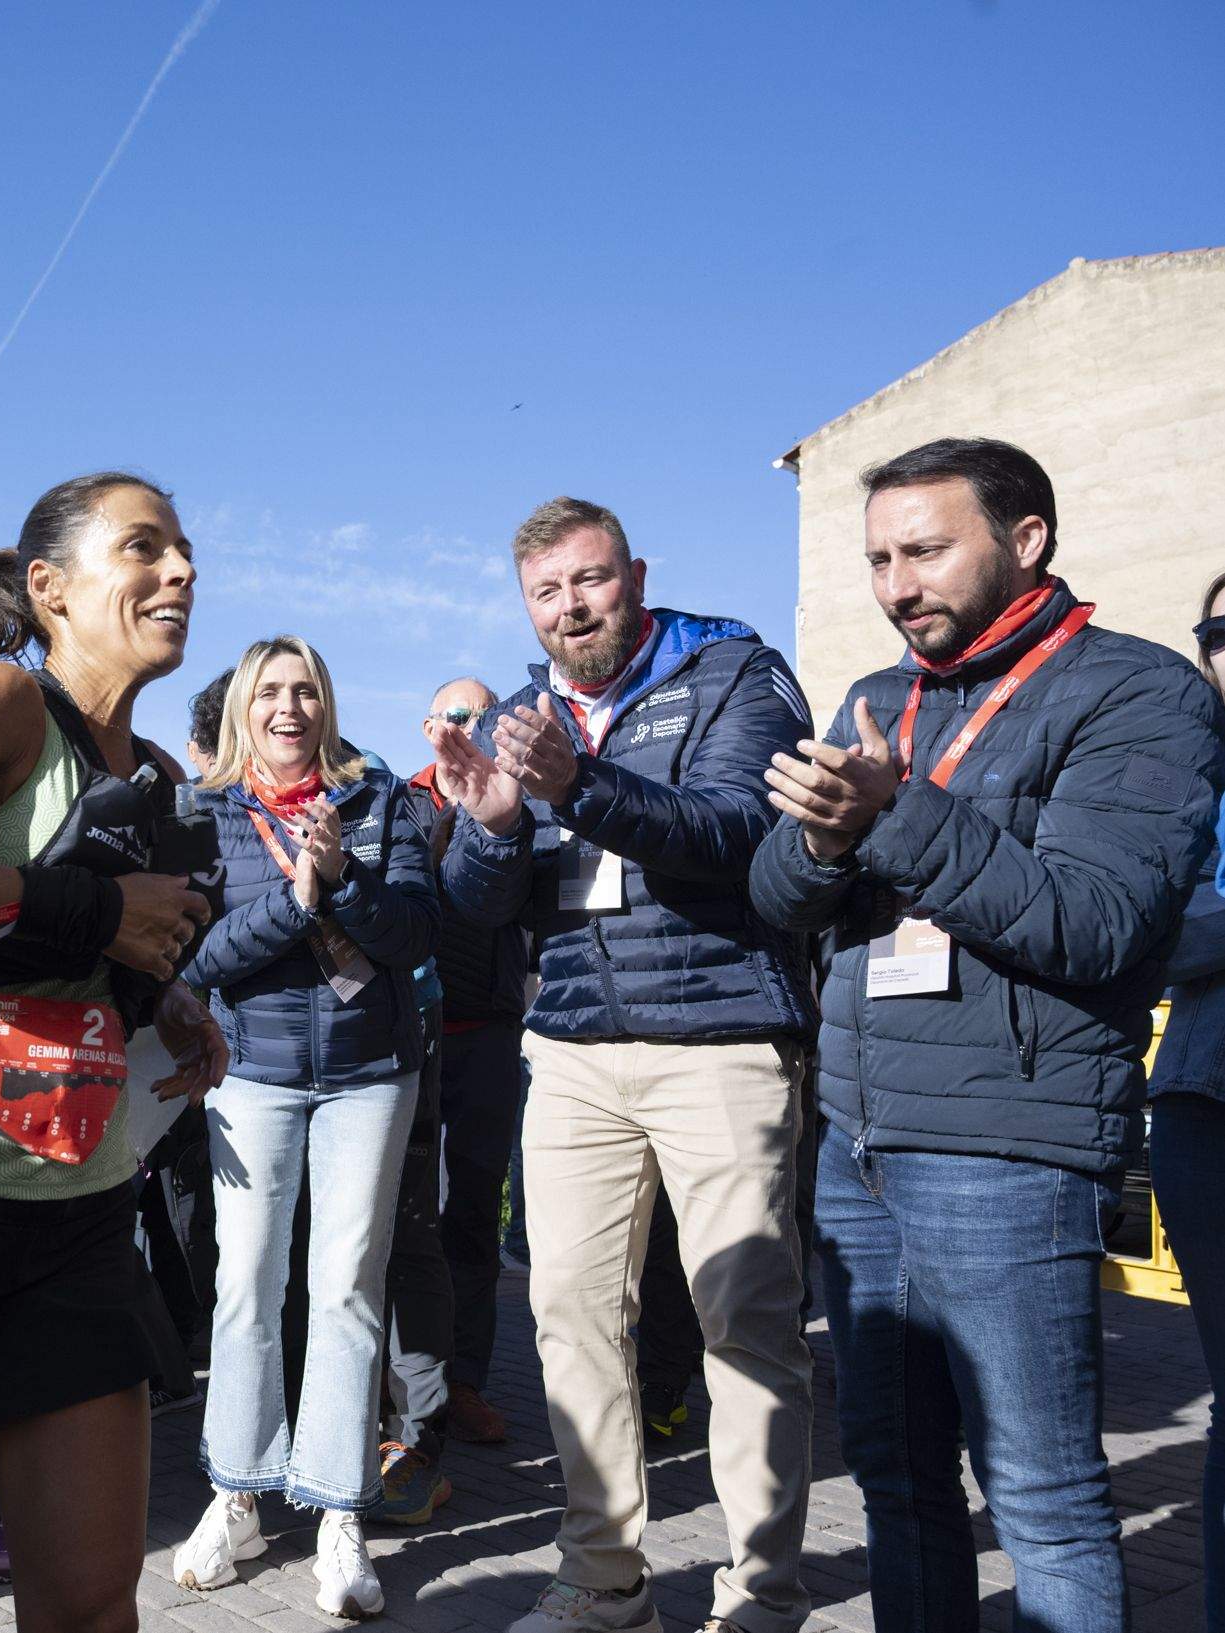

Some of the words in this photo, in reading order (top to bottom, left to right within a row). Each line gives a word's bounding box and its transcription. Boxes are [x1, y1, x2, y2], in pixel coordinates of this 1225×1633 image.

[653, 715, 688, 727] Castellón
[653, 722, 686, 732] Escenario
[653, 729, 686, 738] Deportivo
[81, 1008, 105, 1047] 2
[28, 1044, 70, 1060] GEMMA
[72, 1047, 106, 1063] ARENAS
